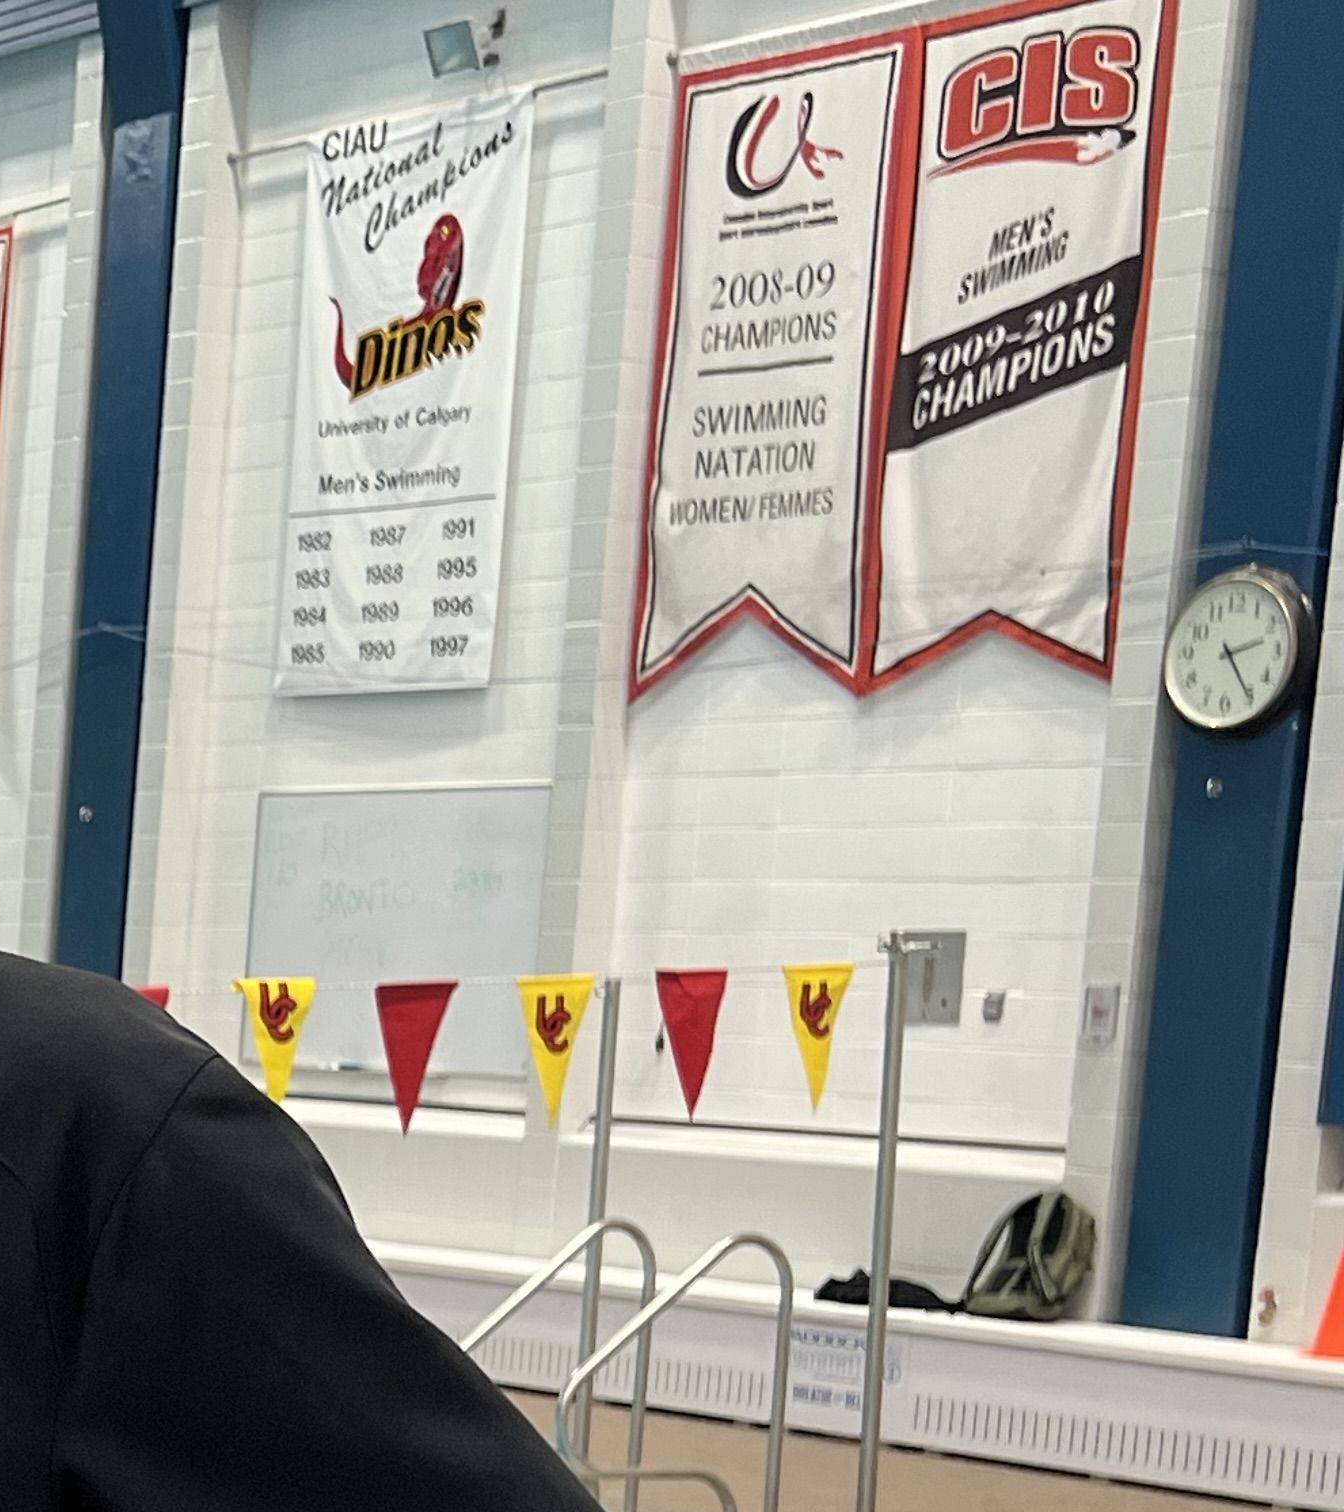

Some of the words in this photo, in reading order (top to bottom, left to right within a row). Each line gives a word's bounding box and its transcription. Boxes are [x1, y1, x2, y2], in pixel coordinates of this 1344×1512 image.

[939, 26, 1139, 160] CIS
[323, 120, 388, 161] CIAU
[321, 120, 443, 218] National
[364, 121, 515, 253] Champions
[988, 206, 1055, 261] MEN'S
[710, 259, 835, 311] 2008-09
[958, 230, 1069, 305] SWIMMING
[351, 298, 485, 399] Dinos
[701, 308, 837, 354] CHAMPIONS
[917, 280, 1115, 385] 2009-2010
[913, 313, 1115, 431] CHAMPIONS
[318, 415, 389, 438] University
[395, 411, 410, 430] of
[416, 404, 472, 427] Calgary
[692, 394, 827, 438] SWIMMING
[318, 471, 369, 496] Men's
[375, 464, 461, 491] Swimming
[695, 439, 815, 480] NATATION
